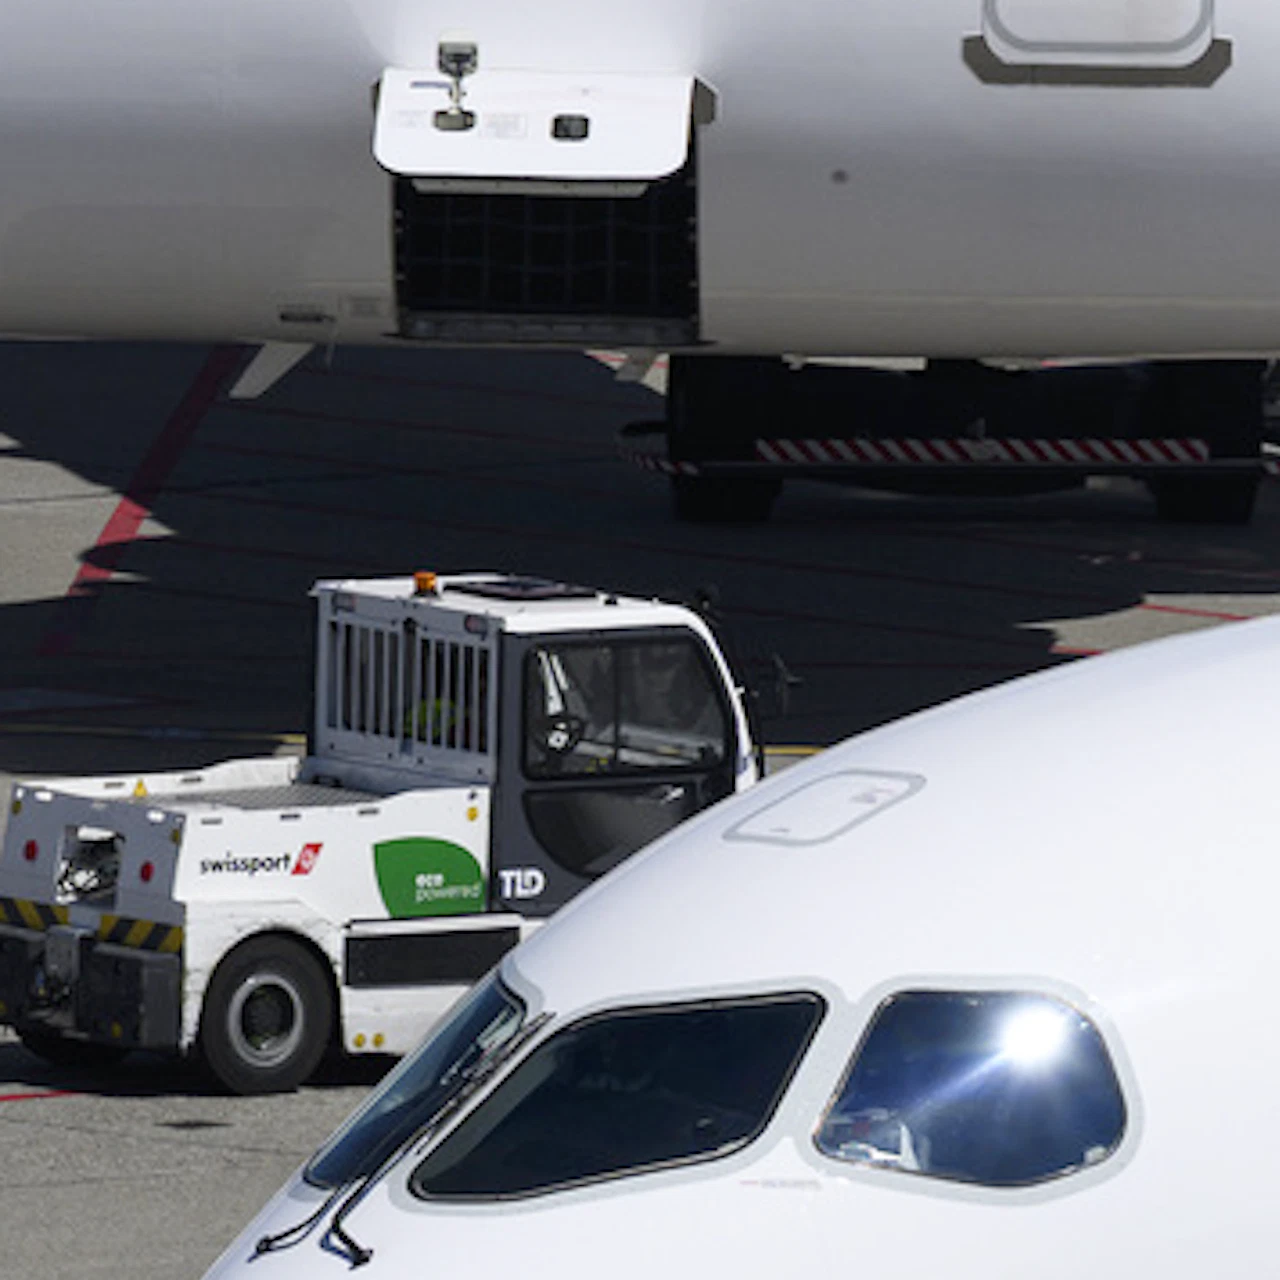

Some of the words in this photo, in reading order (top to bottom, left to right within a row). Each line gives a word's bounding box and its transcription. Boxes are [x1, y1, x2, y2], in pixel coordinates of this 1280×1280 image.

[200, 850, 291, 877] swissport
[415, 873, 444, 888] eco
[500, 869, 546, 899] TLD
